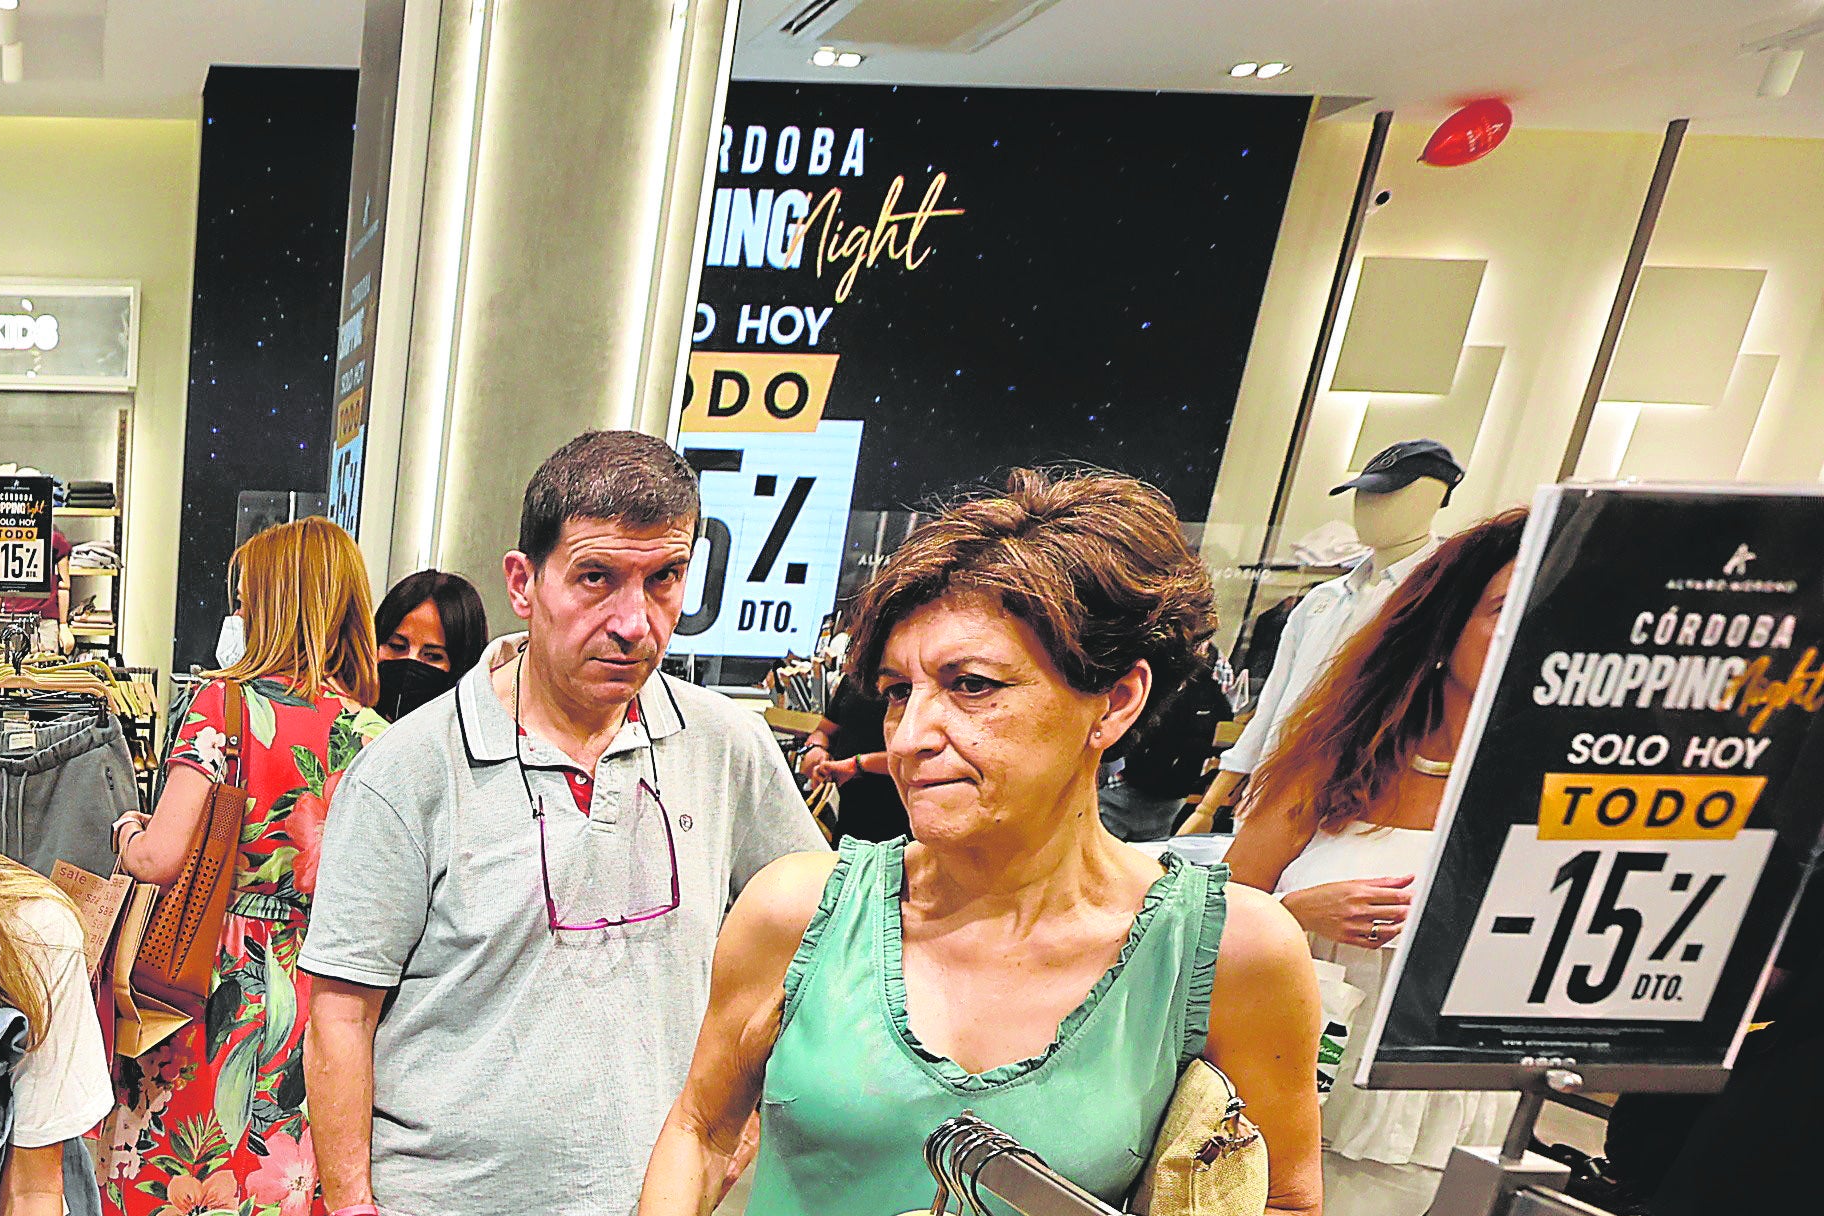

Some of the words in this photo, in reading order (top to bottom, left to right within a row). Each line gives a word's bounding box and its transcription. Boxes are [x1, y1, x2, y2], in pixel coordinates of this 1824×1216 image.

[719, 124, 865, 177] RDOBA
[705, 187, 810, 270] ING
[782, 171, 965, 303] Night
[736, 304, 833, 346] HOY
[682, 369, 809, 419] DO
[19, 518, 36, 526] HOY
[737, 600, 798, 633] DTO.
[1630, 605, 1796, 649] CÓRDOBA
[1533, 651, 1747, 711] SHOPPING
[1567, 732, 1670, 766] SOLO
[1682, 736, 1771, 769] HOY
[1562, 787, 1737, 829] TODO
[59, 867, 87, 885] sale
[1491, 850, 1726, 1005] -15%
[1631, 974, 1683, 1001] DTO.
